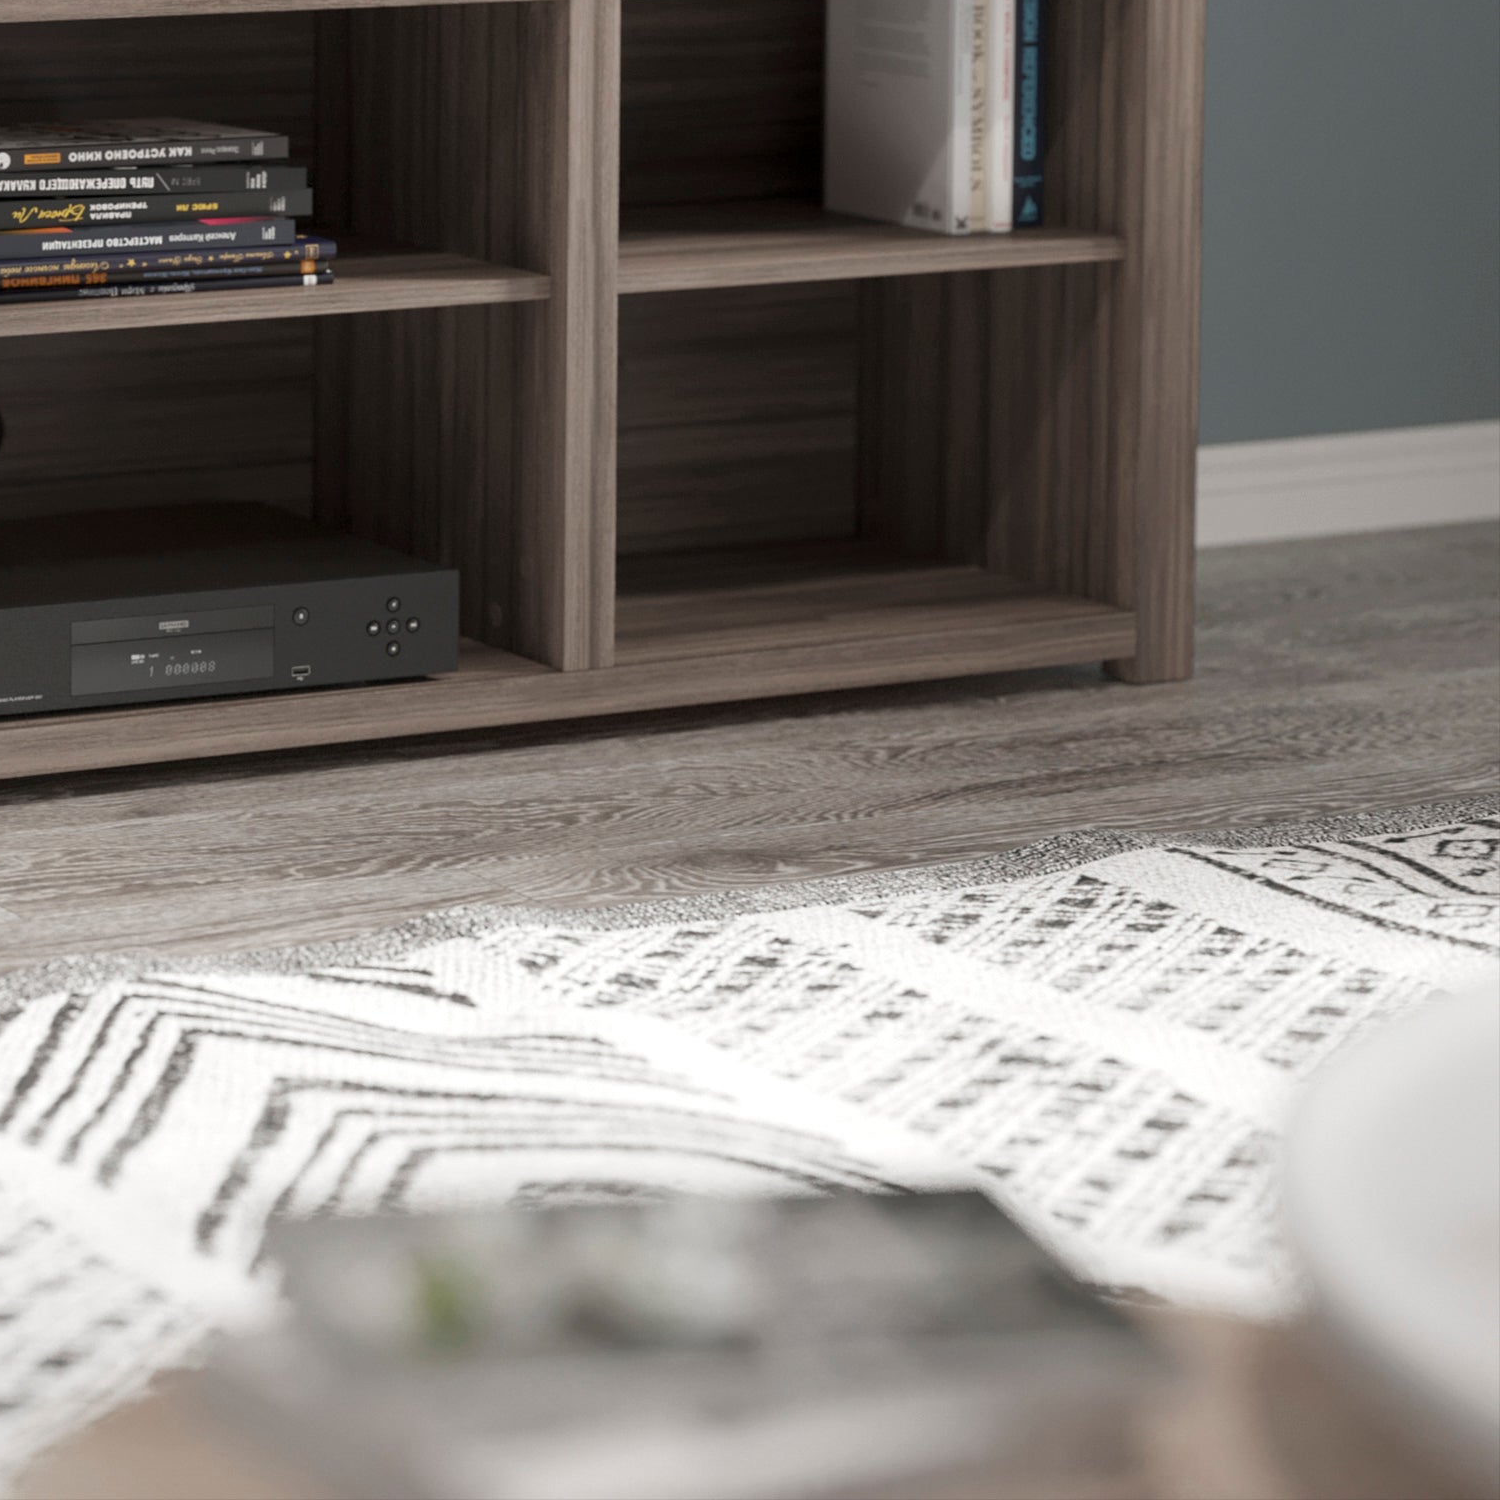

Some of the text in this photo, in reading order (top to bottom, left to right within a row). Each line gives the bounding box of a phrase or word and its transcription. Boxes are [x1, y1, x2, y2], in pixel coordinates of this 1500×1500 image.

[68, 151, 102, 162] КИНО
[104, 148, 167, 160] УСТРОЕНО
[168, 146, 193, 158] КАК
[39, 177, 127, 191] ОПЕРЕЖАЮЩЕГО
[129, 177, 154, 189] ПУТЬ
[90, 202, 148, 211] ТРЕНИРОВОК
[90, 211, 132, 220] ПРАВИЛА
[42, 235, 163, 251] МАСТЕРСТВО ПРЕЗЕНТАЦИИ
